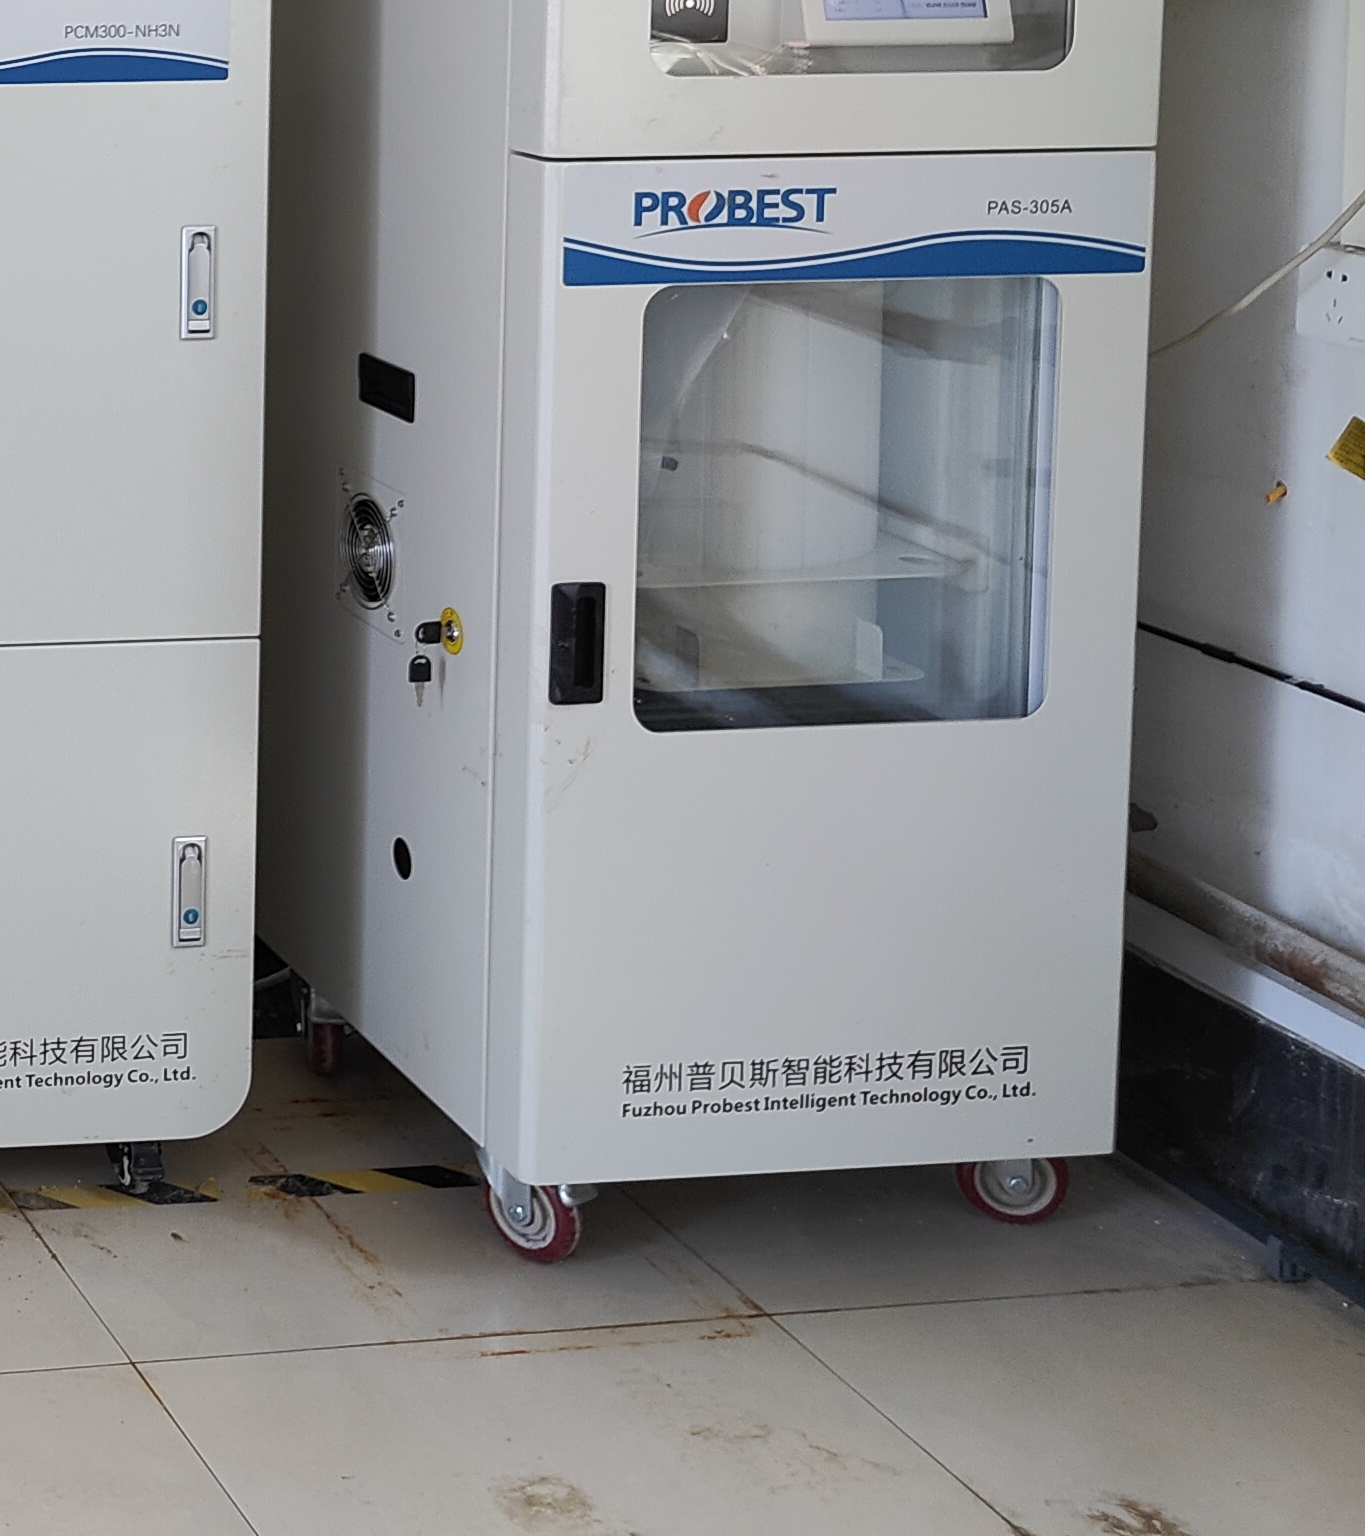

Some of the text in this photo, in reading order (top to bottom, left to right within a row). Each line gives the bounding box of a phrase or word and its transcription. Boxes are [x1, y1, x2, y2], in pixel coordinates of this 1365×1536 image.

[64, 24, 181, 39] PCM300-NH3N
[633, 188, 836, 227] PROBEST
[986, 199, 1073, 215] PAS-305A
[25, 1071, 123, 1088] Technology
[128, 1070, 158, 1083] Co.,
[164, 1066, 196, 1081] Ltd.
[623, 1046, 1028, 1094] 福州普贝斯智能科技有限公司
[623, 1081, 1036, 1117] Fuzhou Probest Intelligent Technology Co., Ltd.
